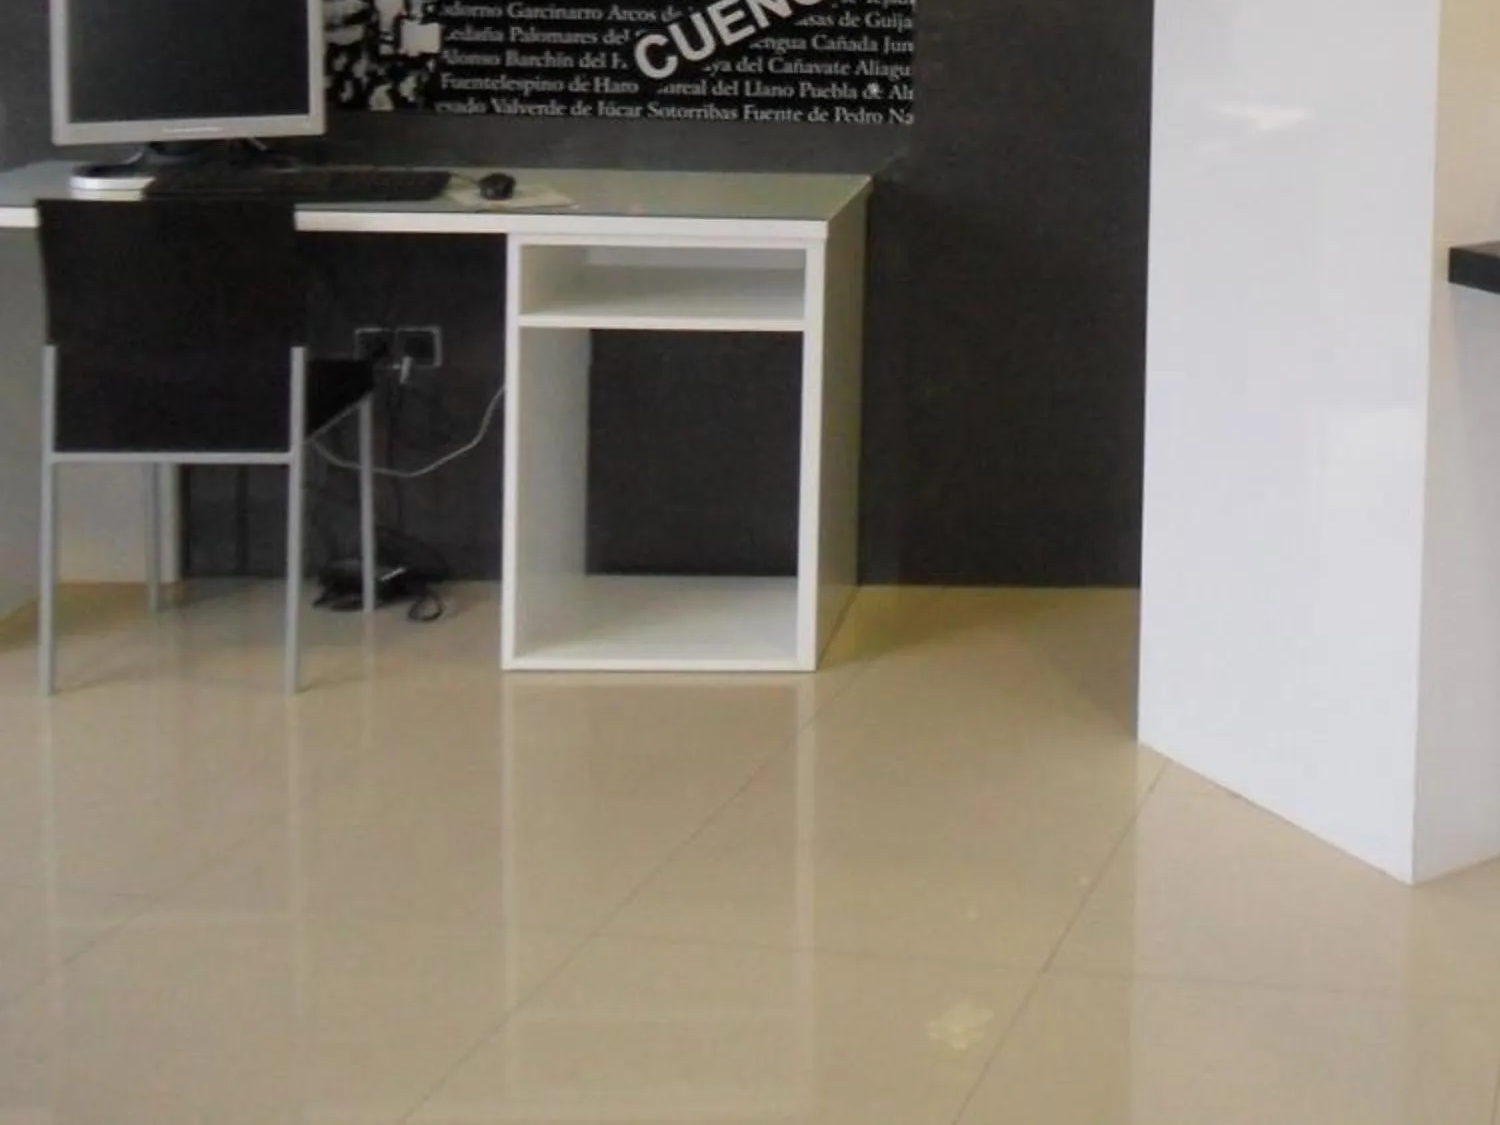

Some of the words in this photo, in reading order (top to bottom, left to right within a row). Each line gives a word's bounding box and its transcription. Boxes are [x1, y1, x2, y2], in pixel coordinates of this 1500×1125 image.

[507, 1, 603, 21] Garcinarro
[607, 3, 656, 22] Arcos
[838, 10, 860, 28] de
[509, 25, 600, 45] Palomares
[811, 34, 879, 53] Cañada
[579, 51, 607, 69] del
[735, 56, 763, 74] del
[767, 56, 850, 76] Cañavate
[440, 72, 563, 97] Fuentelespino
[568, 74, 590, 93] de
[594, 75, 640, 94] Haro
[711, 79, 739, 97] del
[744, 80, 795, 99] Llano
[799, 81, 858, 100] Puebla
[491, 97, 568, 117] Valverde
[570, 99, 593, 117] de
[647, 102, 738, 122] Sotorribas
[743, 103, 803, 123] Fuente
[807, 105, 829, 123] de
[833, 105, 884, 126] Pedro
